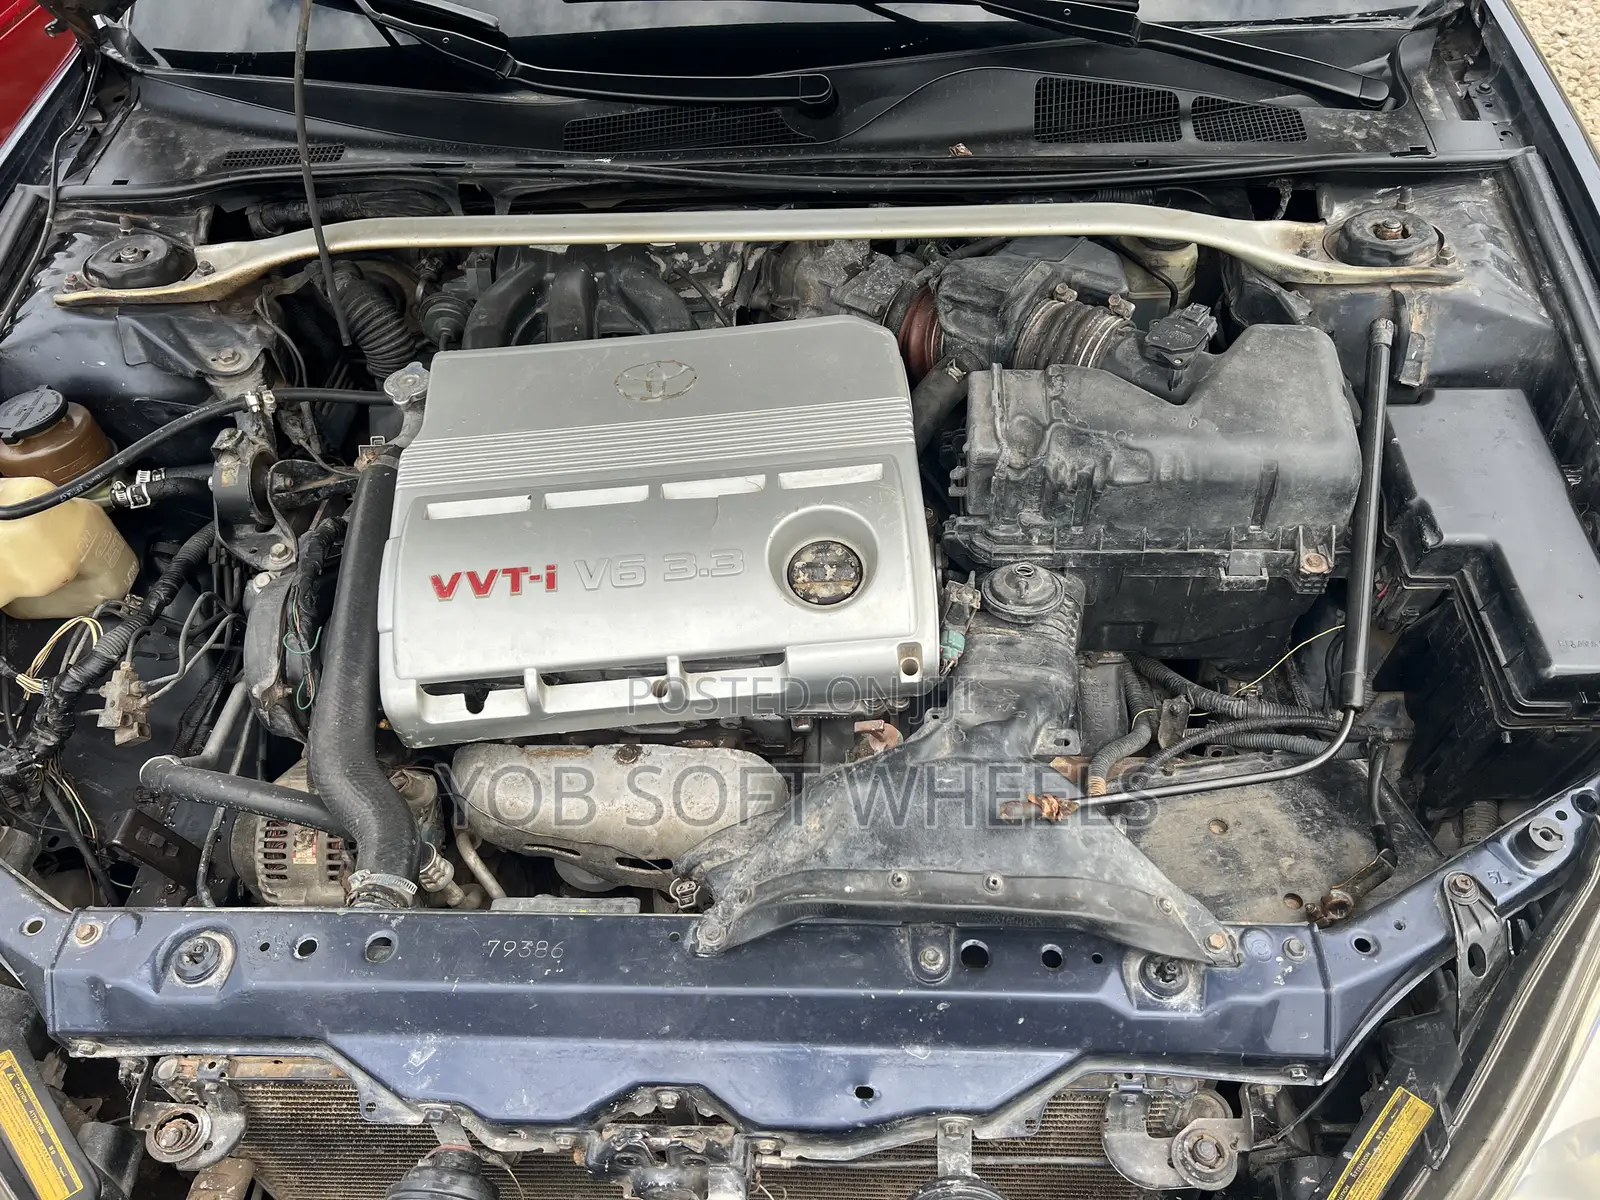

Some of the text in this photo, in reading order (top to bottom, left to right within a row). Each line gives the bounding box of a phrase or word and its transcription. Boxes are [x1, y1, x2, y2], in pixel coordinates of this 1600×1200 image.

[429, 548, 746, 602] VVT-i V6 3.3
[487, 940, 565, 959] 79386
[14, 1083, 29, 1104] CAUTION
[1350, 1151, 1371, 1179] ATTENTION
